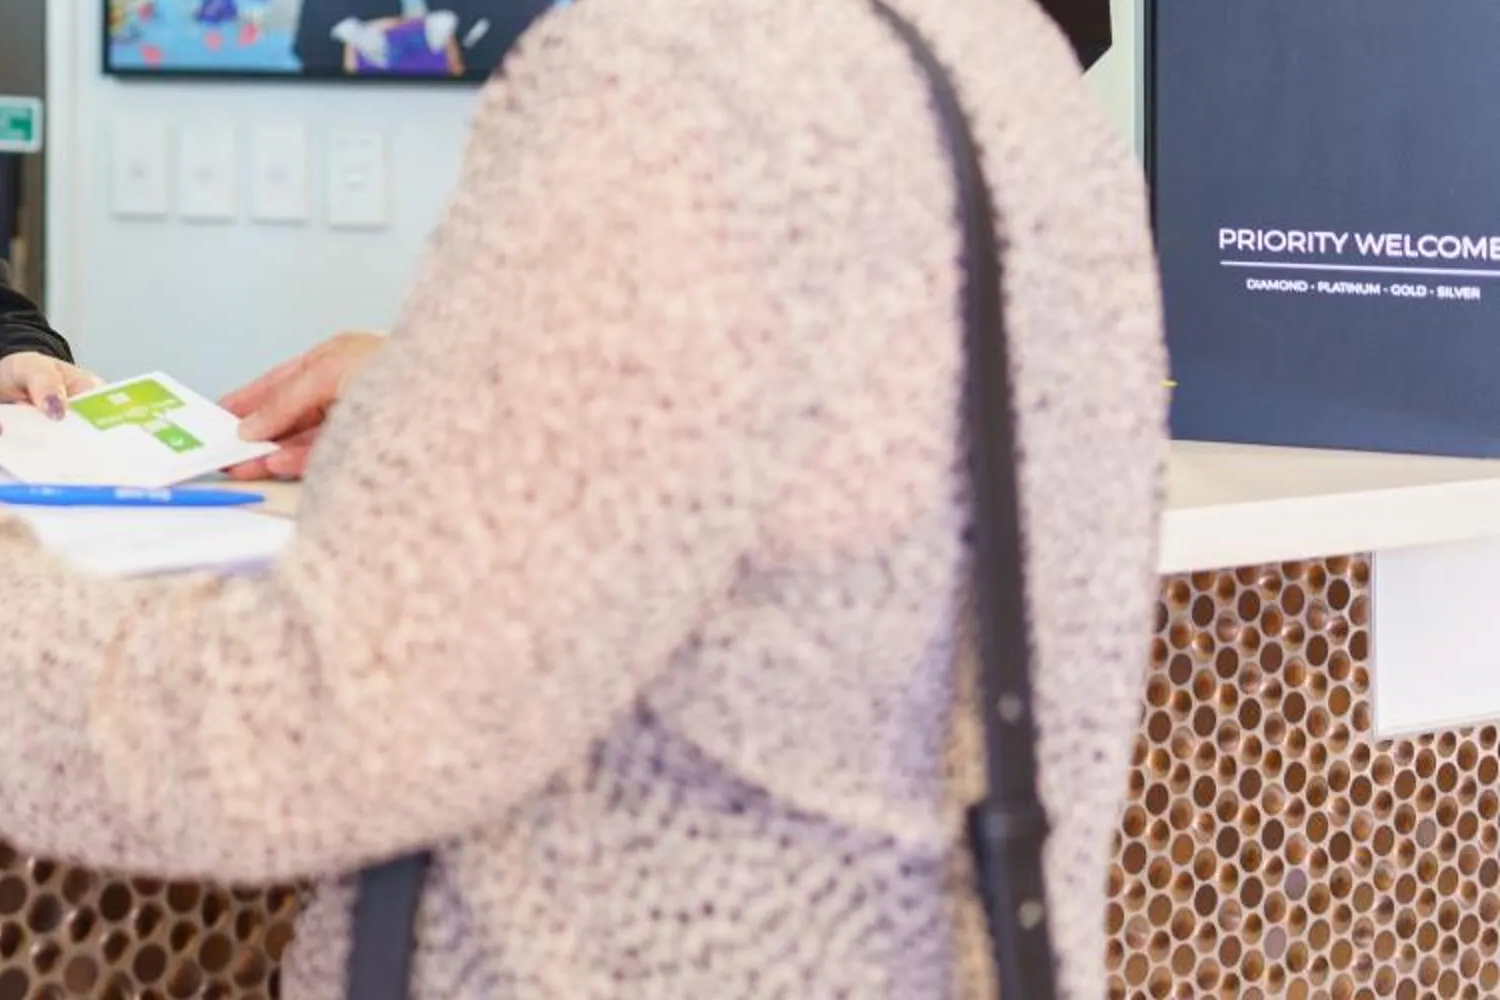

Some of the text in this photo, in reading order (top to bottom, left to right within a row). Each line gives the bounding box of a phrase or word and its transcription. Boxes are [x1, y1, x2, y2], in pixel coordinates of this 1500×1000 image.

[1218, 228, 1500, 261] PRIORITY WELCOME
[1246, 278, 1481, 301] DIAMOND PLATINUM GOLD SILVER
